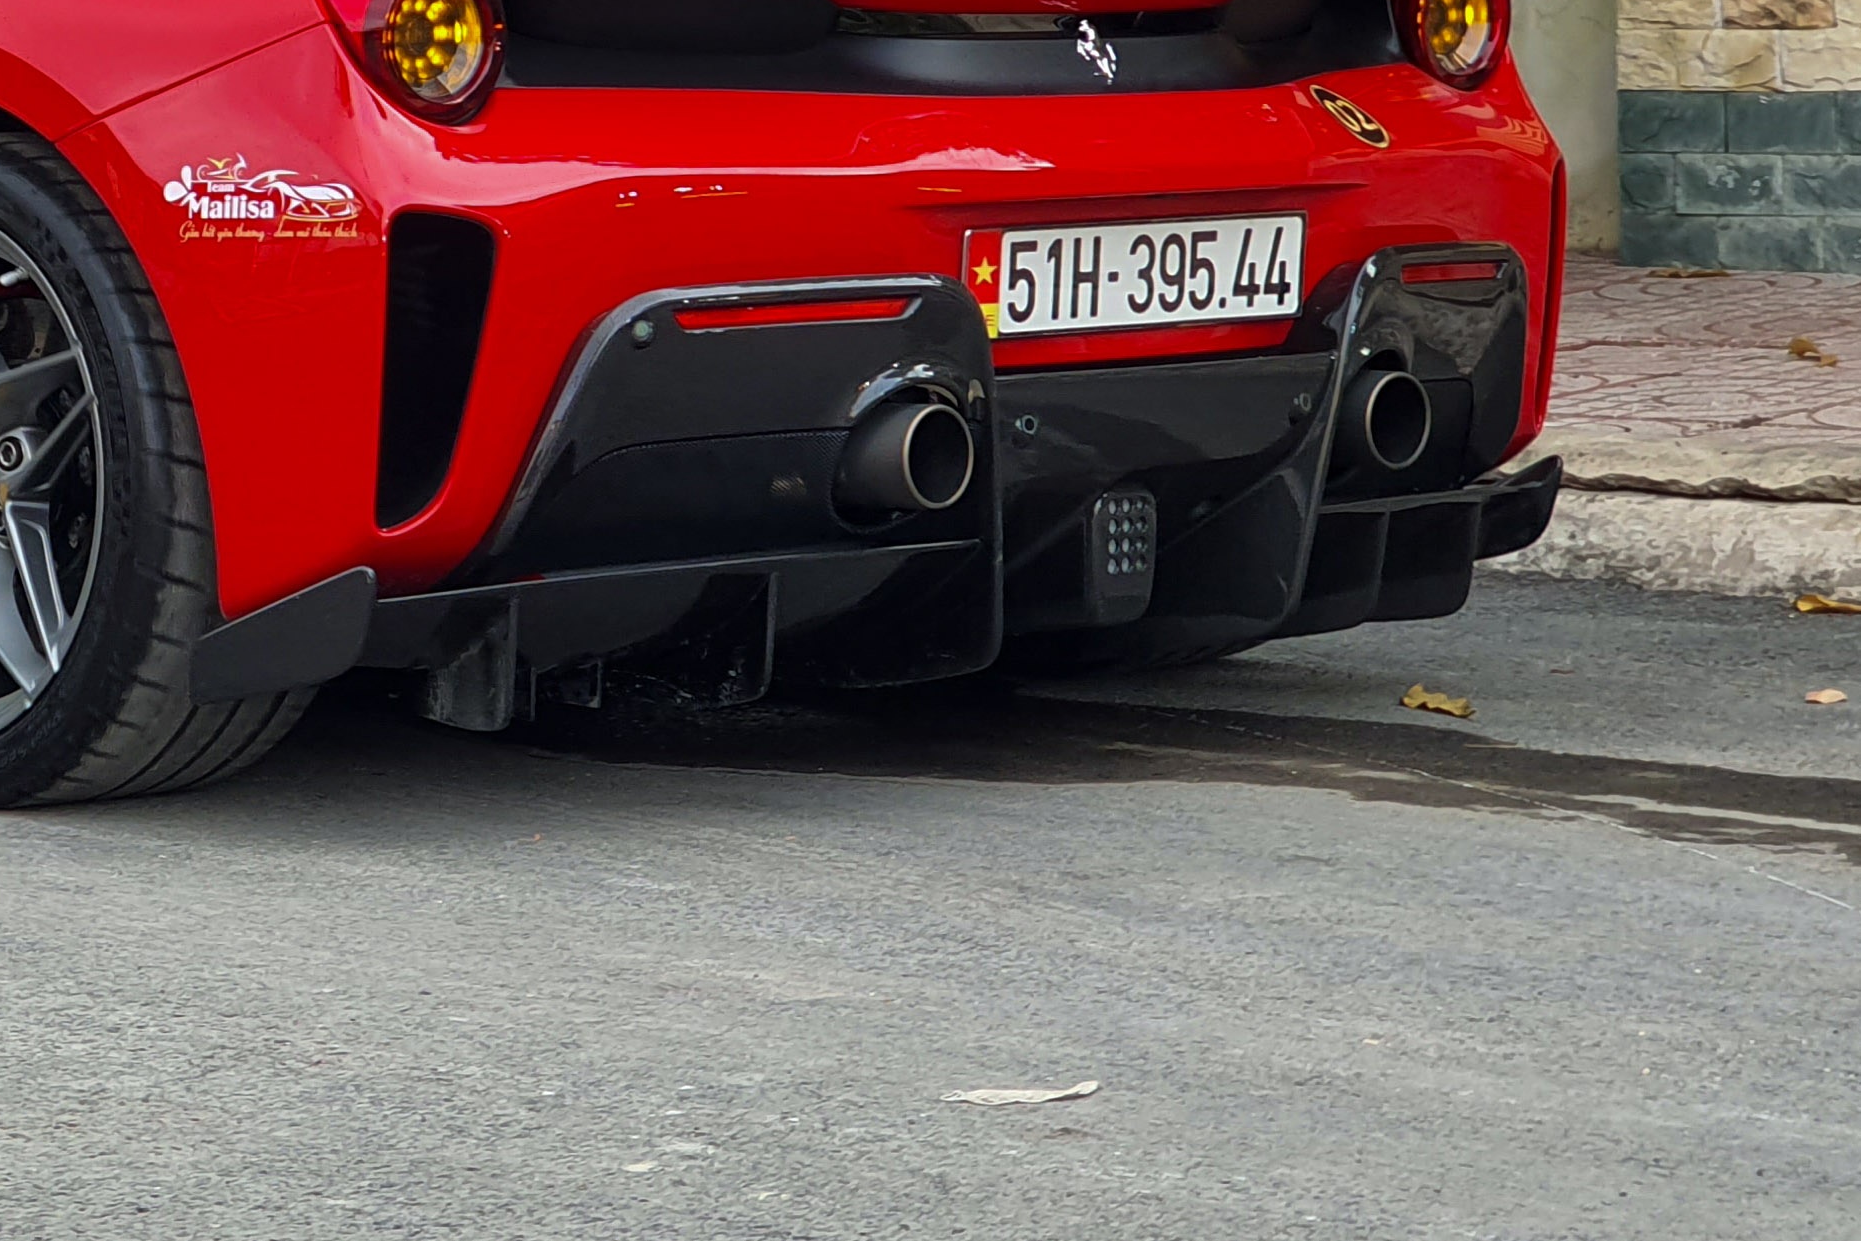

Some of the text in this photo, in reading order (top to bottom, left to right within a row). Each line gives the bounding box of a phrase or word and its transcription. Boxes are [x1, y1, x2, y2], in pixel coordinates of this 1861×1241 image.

[206, 181, 235, 193] Team
[188, 193, 275, 220] Mailisa
[1006, 226, 1291, 323] 51H-395.44
